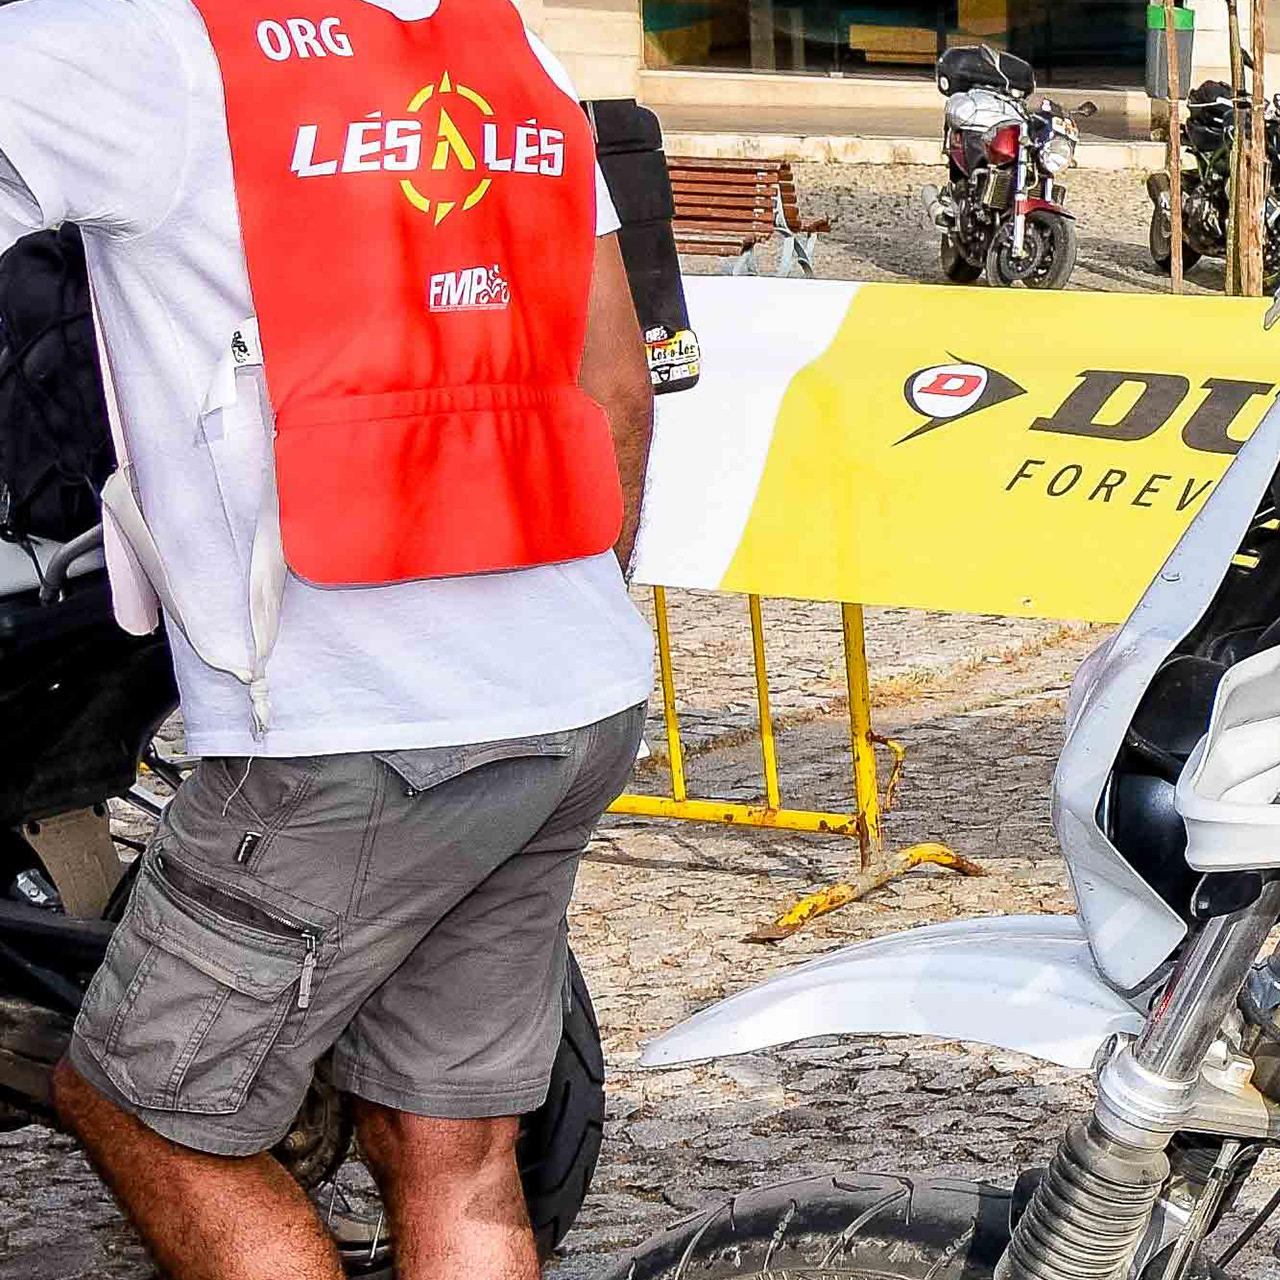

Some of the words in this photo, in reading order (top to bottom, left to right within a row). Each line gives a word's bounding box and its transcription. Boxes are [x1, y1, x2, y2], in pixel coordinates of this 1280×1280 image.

[256, 17, 354, 62] ORG
[290, 110, 422, 178] LÉS
[482, 118, 565, 177] LÉS
[430, 266, 488, 306] FMP
